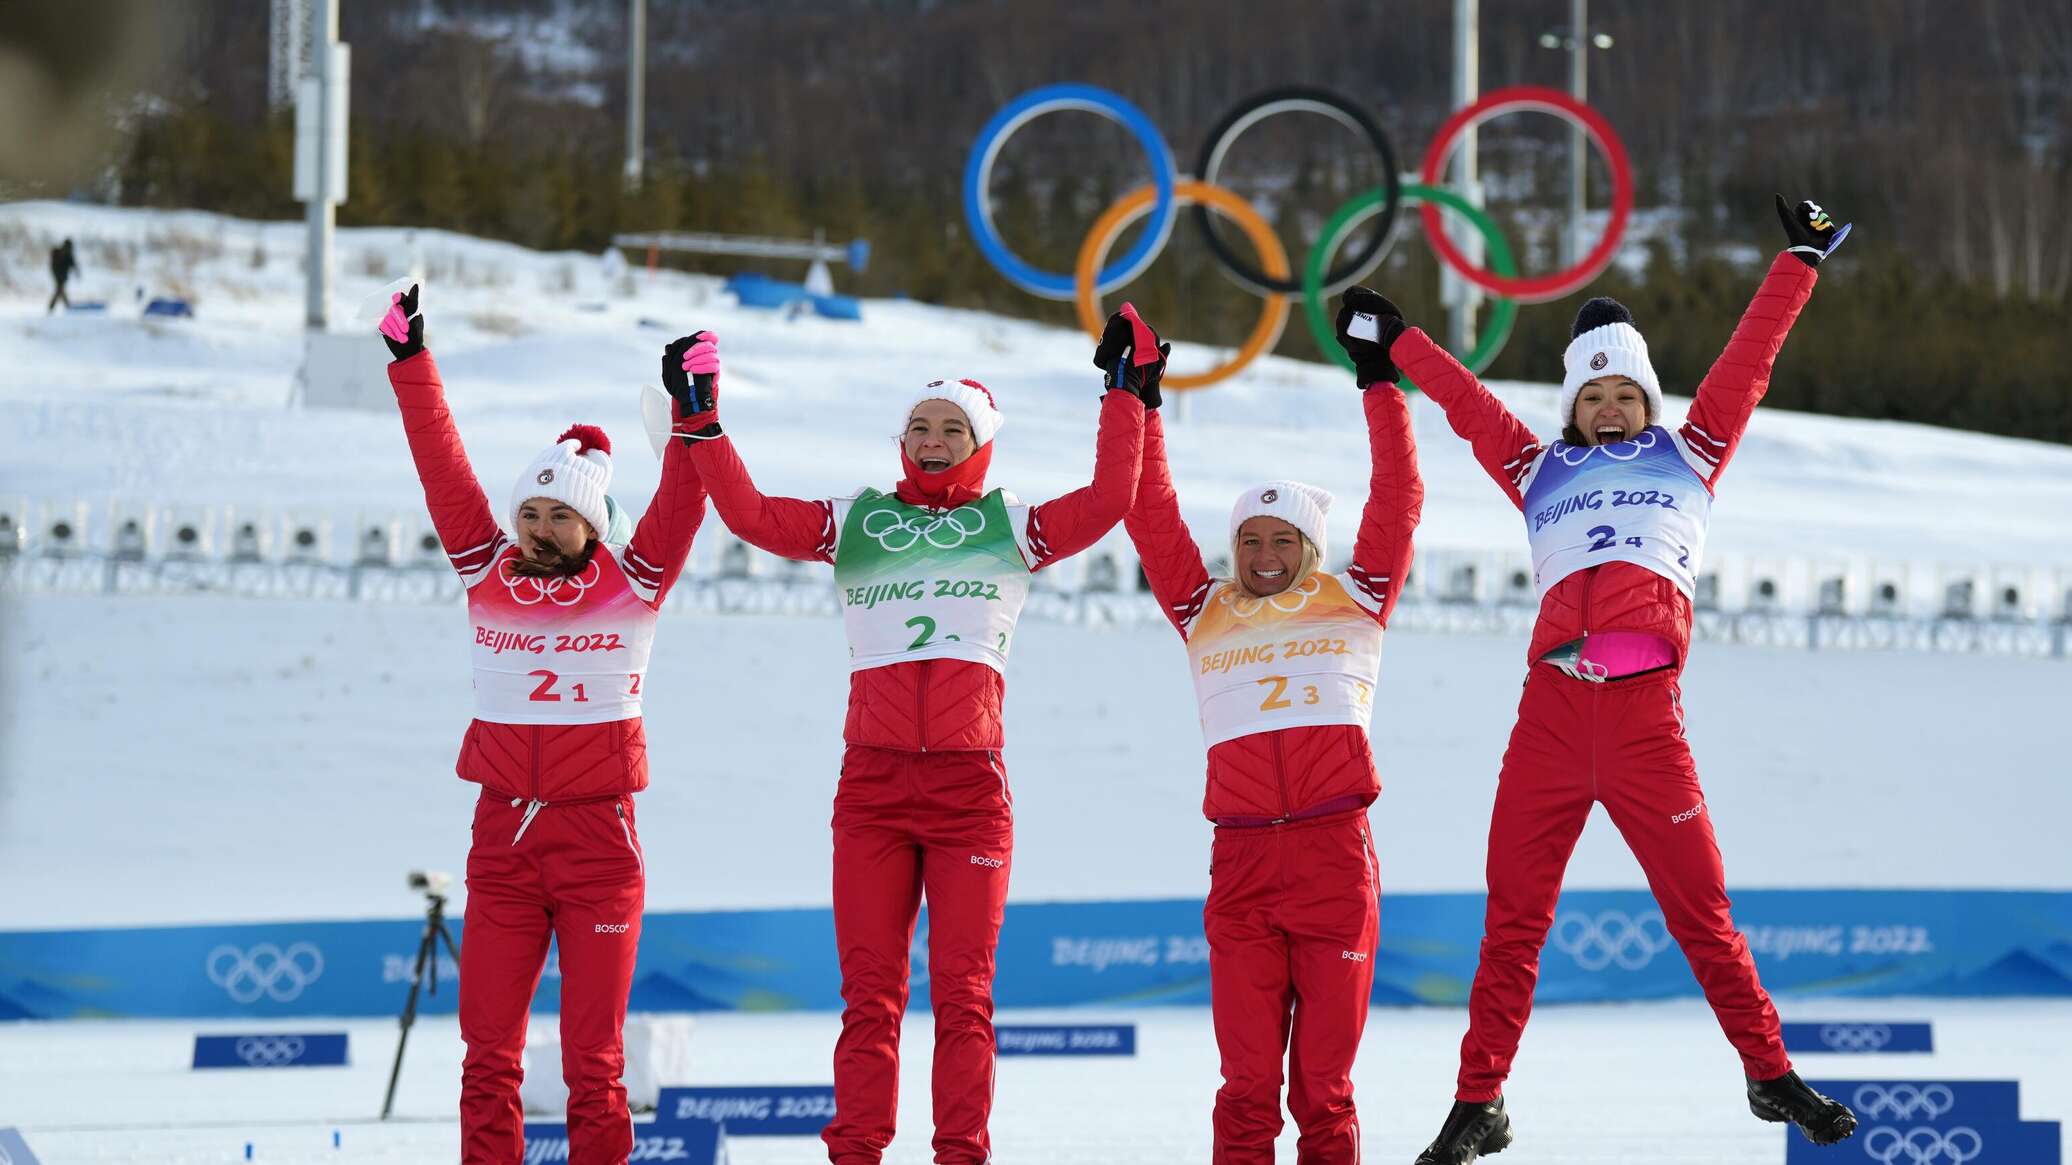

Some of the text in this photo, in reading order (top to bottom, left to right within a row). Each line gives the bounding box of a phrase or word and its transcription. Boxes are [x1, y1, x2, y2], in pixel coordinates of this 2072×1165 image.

[1534, 489, 1680, 533] BEIJING 2022
[1586, 525, 1643, 553] 2 4
[1677, 545, 1689, 569] 2
[846, 580, 1002, 610] BEIJING 2022
[475, 626, 626, 654] BEIJING 2022
[905, 615, 936, 651] 2
[1200, 639, 1352, 675] BEIJING 2022
[528, 669, 589, 702] 2 1
[629, 674, 641, 694] 2
[1255, 675, 1320, 711] 2 3
[1358, 682, 1369, 705] 2
[1671, 804, 1702, 824] BOSCO
[970, 855, 1001, 868] BOSCO
[594, 924, 626, 933] BOSCO
[1852, 925, 1934, 954] 2022
[1053, 936, 1159, 973] BEIJING
[676, 1097, 771, 1122] BEIJING
